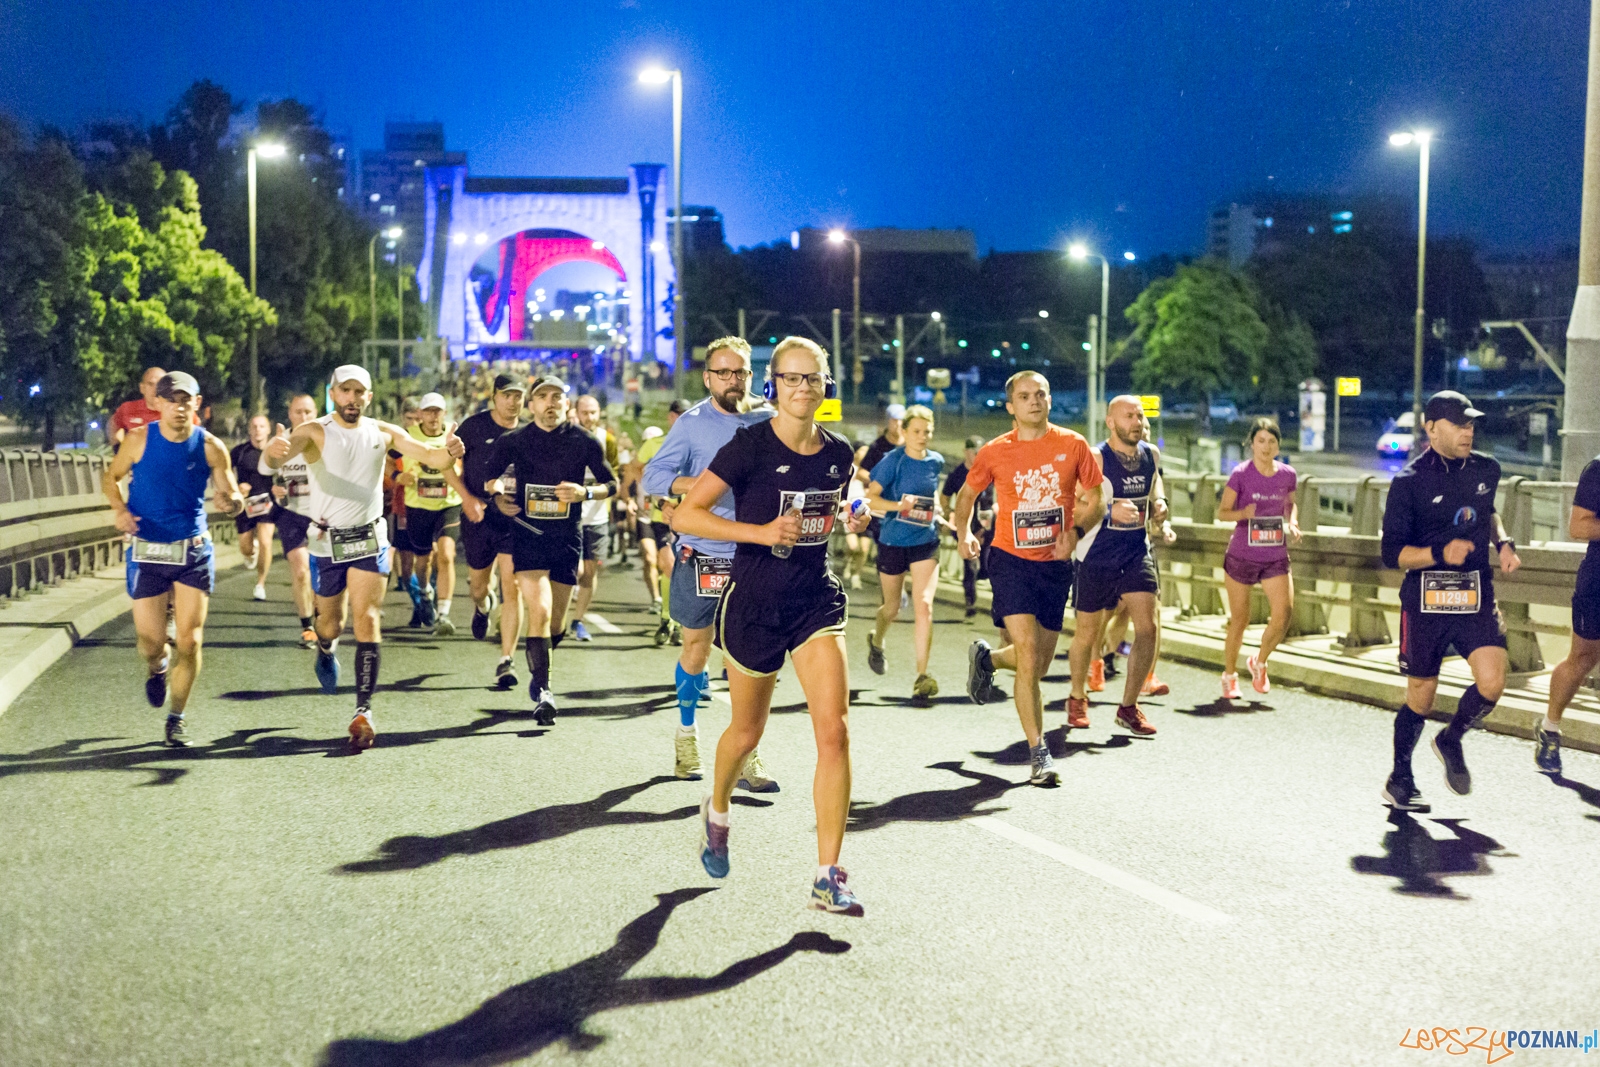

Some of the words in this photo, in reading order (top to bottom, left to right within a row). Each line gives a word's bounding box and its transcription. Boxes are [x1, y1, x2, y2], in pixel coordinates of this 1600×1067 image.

[535, 501, 559, 512] 6480
[1026, 526, 1053, 540] 6906
[146, 543, 172, 556] 2374
[341, 541, 368, 555] 3942
[1435, 591, 1469, 604] 11294
